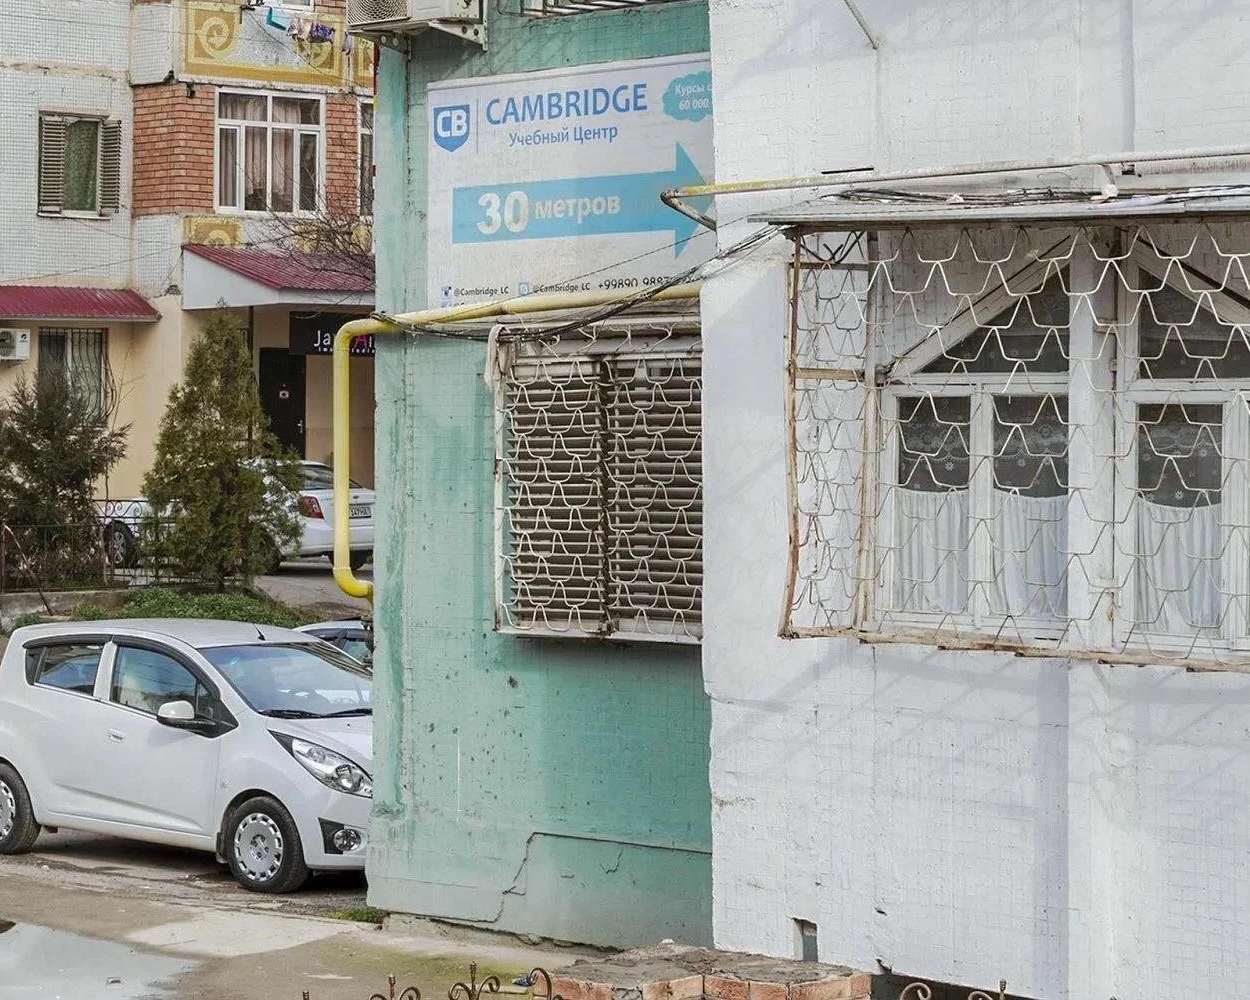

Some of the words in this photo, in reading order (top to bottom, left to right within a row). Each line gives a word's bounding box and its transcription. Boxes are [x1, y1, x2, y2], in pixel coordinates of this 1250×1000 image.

[675, 84, 704, 96] Курсы
[485, 83, 648, 126] CAMBRIDGE
[679, 100, 690, 110] 60
[693, 99, 709, 109] 000
[436, 109, 468, 138] CB
[509, 128, 570, 148] Учебный
[574, 126, 618, 146] Центр
[476, 190, 530, 235] 30
[535, 195, 621, 225] метров
